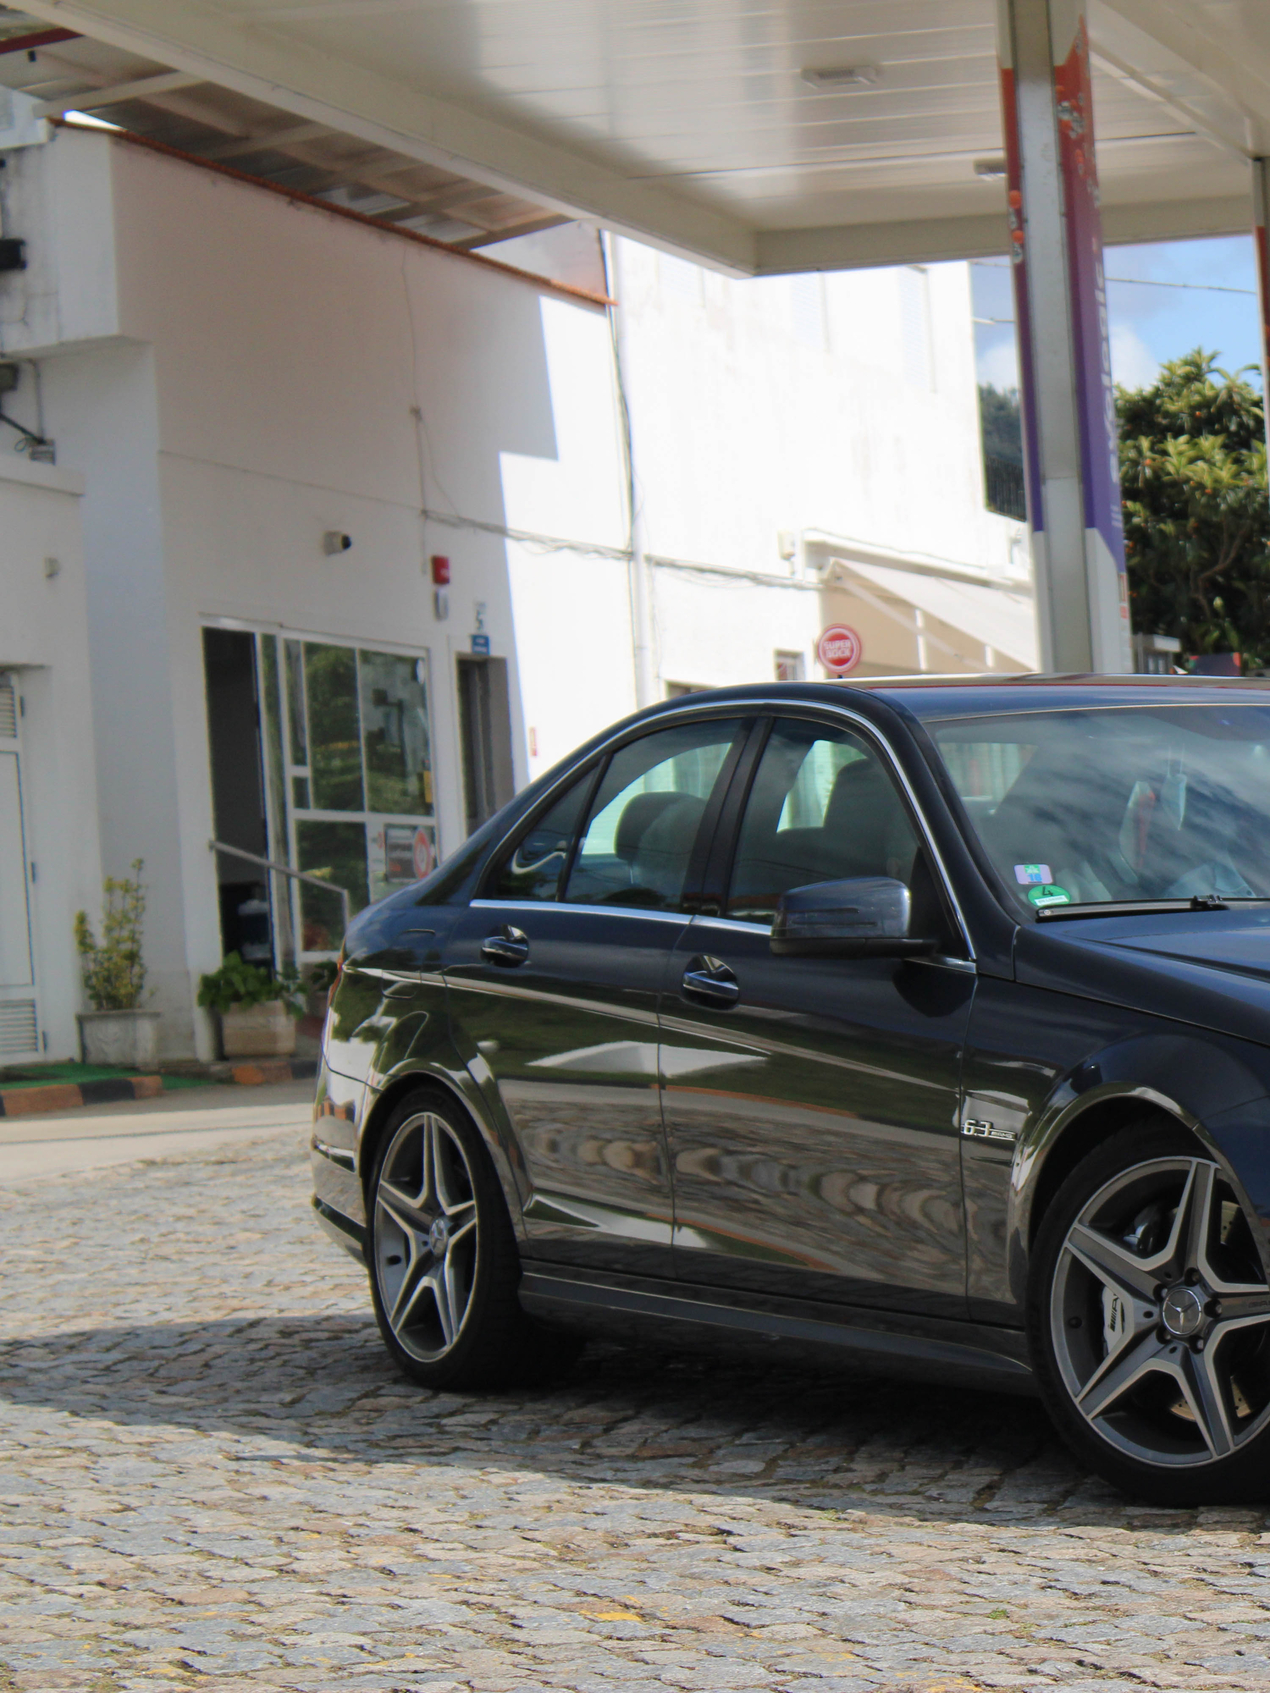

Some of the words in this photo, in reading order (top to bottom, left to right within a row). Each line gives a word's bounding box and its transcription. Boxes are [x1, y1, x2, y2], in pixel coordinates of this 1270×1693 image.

[824, 639, 851, 650] SUPER
[826, 647, 851, 658] BOCK
[1042, 886, 1054, 896] 4
